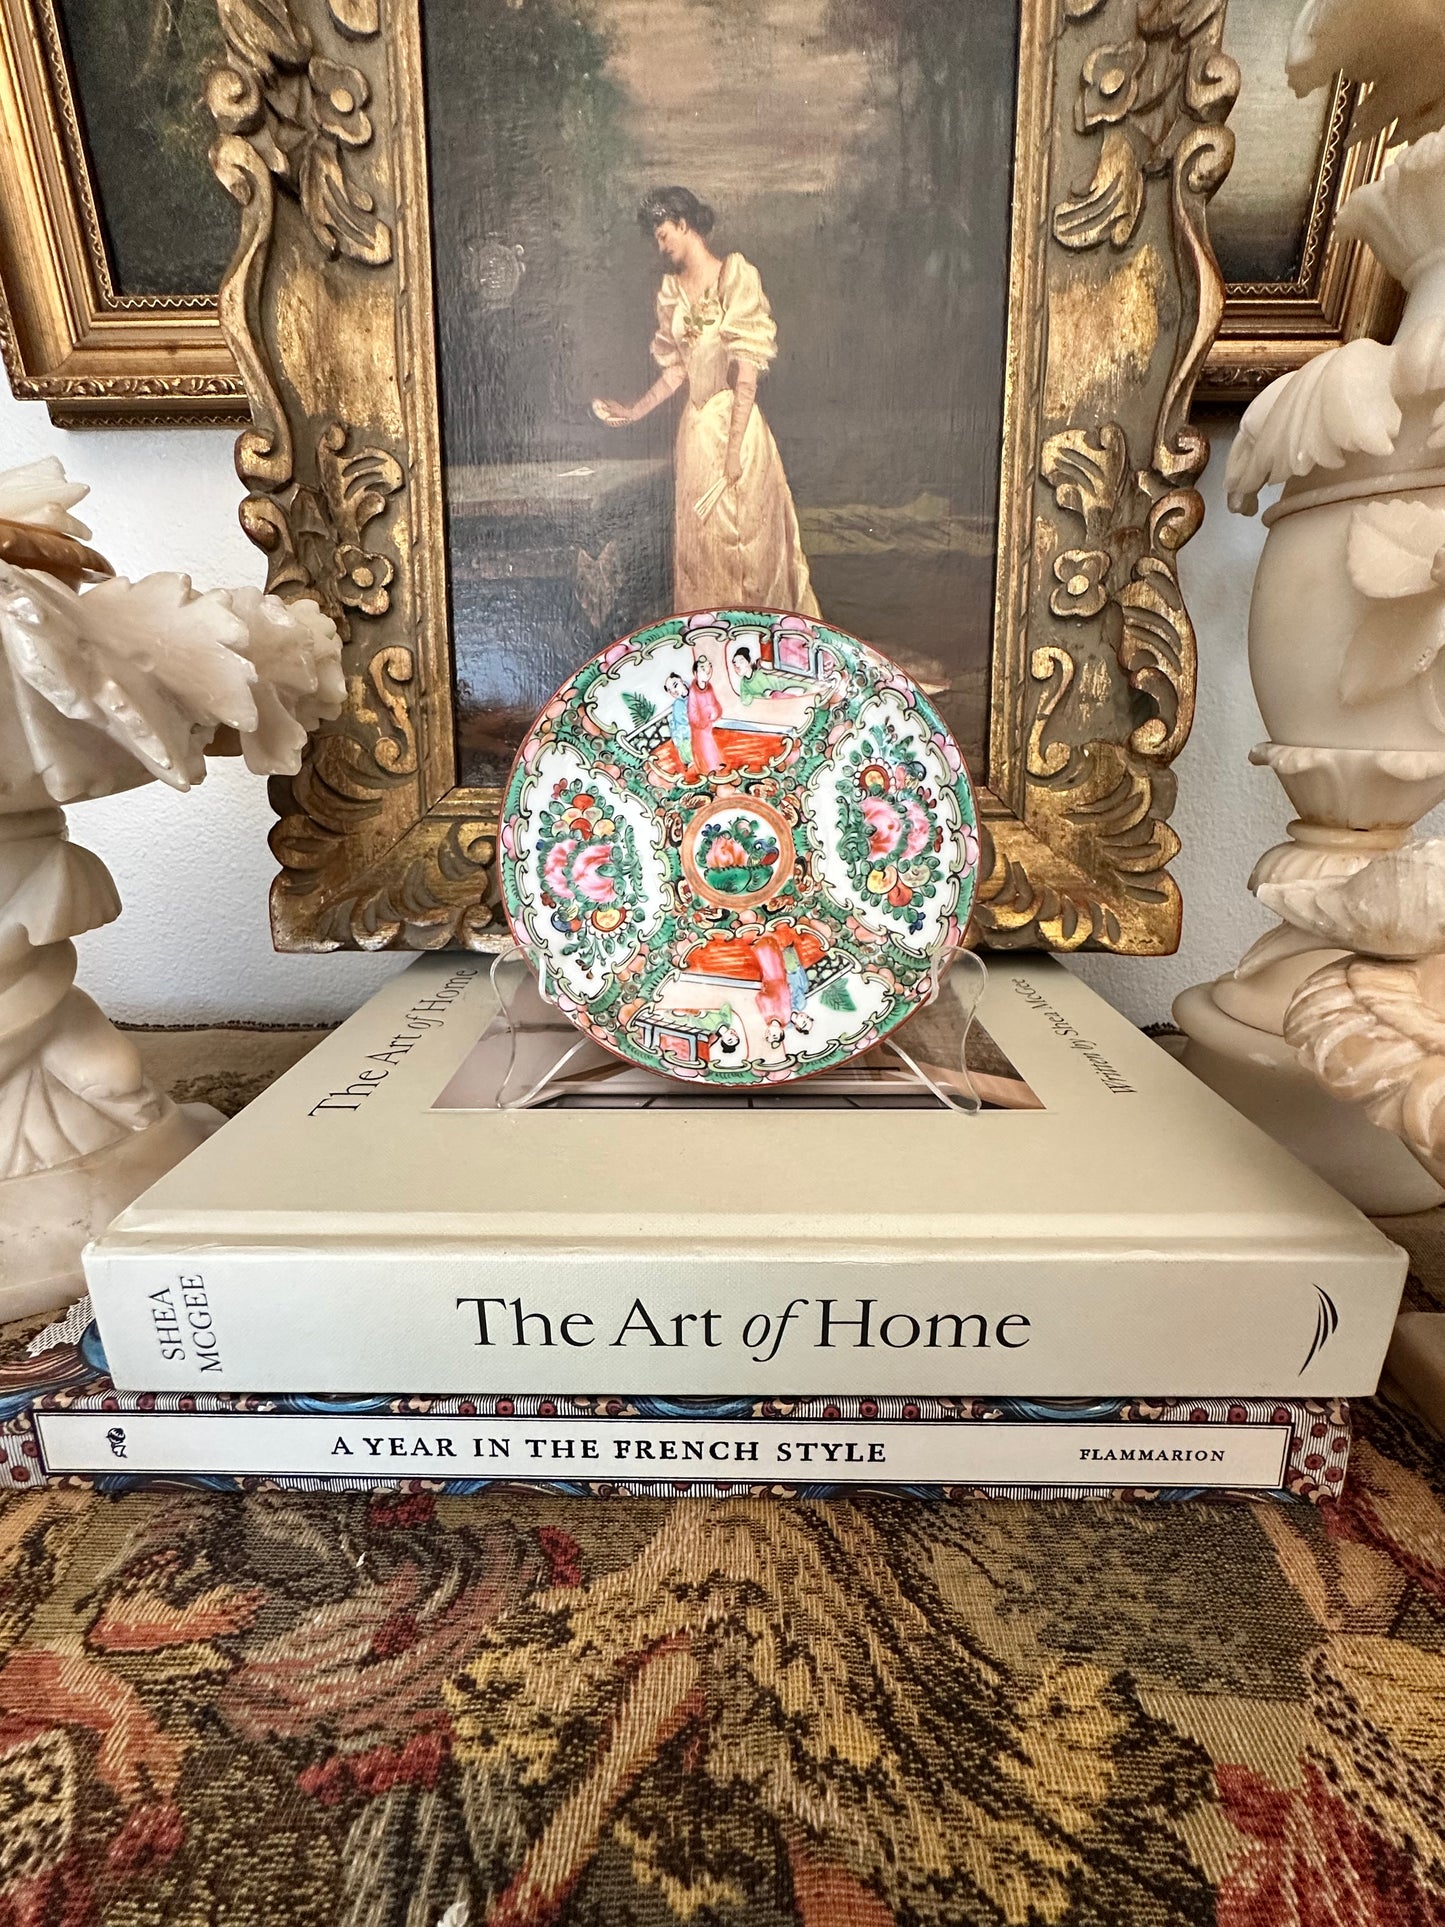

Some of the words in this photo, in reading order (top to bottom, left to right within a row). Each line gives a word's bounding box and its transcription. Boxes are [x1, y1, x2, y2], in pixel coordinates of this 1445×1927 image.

[411, 969, 478, 1012] Home
[405, 1013, 444, 1030] of
[1044, 1011, 1079, 1036] Shea
[365, 1033, 422, 1066] Art
[1069, 1038, 1097, 1051] by
[1083, 1052, 1137, 1094] Written
[307, 1069, 389, 1117] The
[148, 1287, 186, 1361] SHEA
[179, 1274, 223, 1373] MCGEE
[456, 1297, 595, 1347] The
[609, 1298, 722, 1347] Art
[742, 1299, 809, 1362] of
[814, 1299, 1031, 1348] Home
[331, 1436, 354, 1455] A
[362, 1437, 457, 1457] YEAR
[473, 1438, 510, 1457] IN
[525, 1439, 599, 1459] THE
[613, 1440, 759, 1461] FRENCH
[777, 1443, 886, 1462] STYLE
[1080, 1449, 1225, 1461] FLAMMARION
